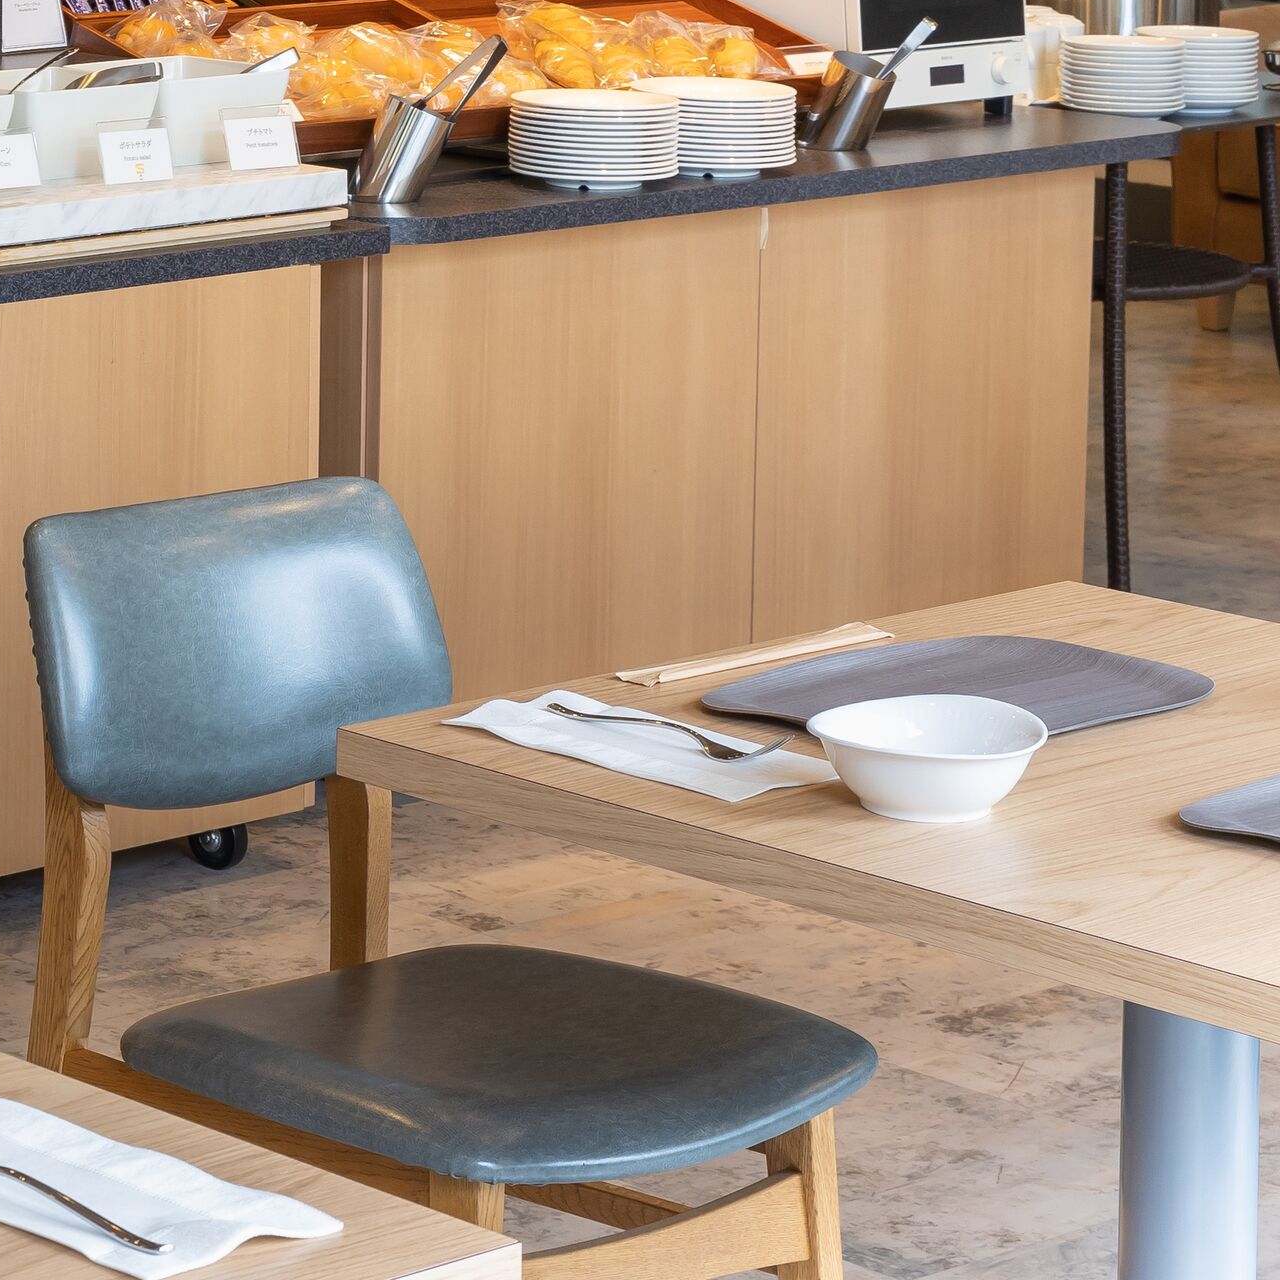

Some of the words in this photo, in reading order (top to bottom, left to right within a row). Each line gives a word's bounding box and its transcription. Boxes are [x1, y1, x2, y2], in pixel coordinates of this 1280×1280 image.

[119, 139, 152, 150] ポテトサラダ
